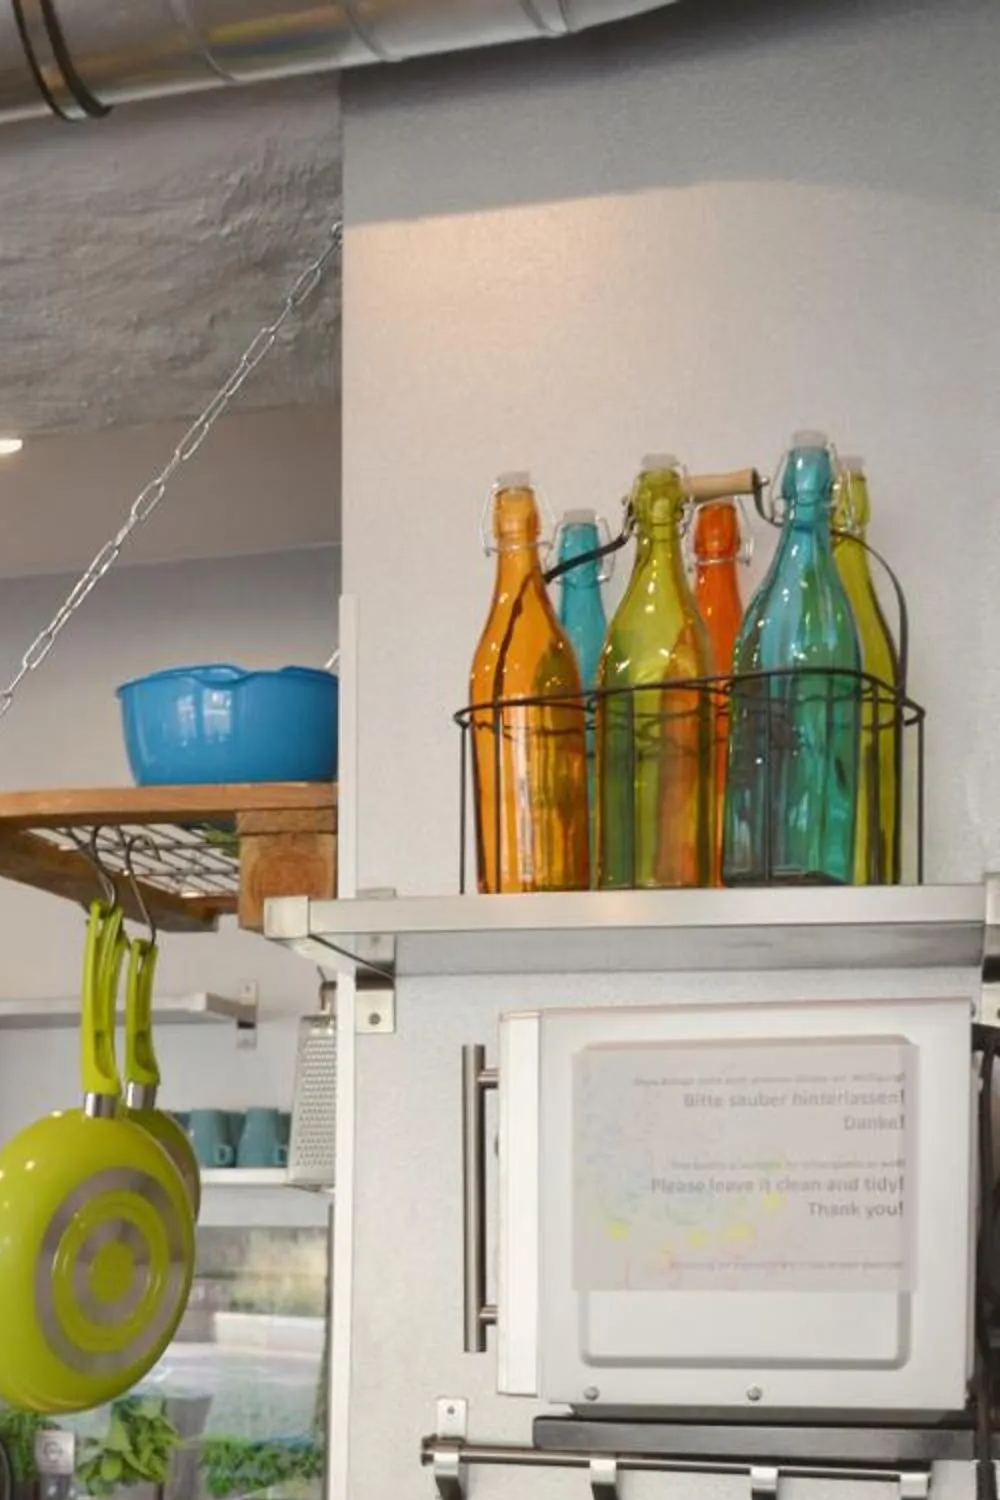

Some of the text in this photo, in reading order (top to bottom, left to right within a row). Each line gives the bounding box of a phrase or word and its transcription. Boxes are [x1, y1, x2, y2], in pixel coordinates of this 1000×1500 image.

[729, 1091, 787, 1108] sauber
[651, 1177, 705, 1194] Please
[709, 1175, 755, 1193] leave
[776, 1175, 822, 1192] clean
[826, 1175, 860, 1192] and
[864, 1175, 905, 1195] tidy!
[808, 1200, 905, 1220] Thank you!
